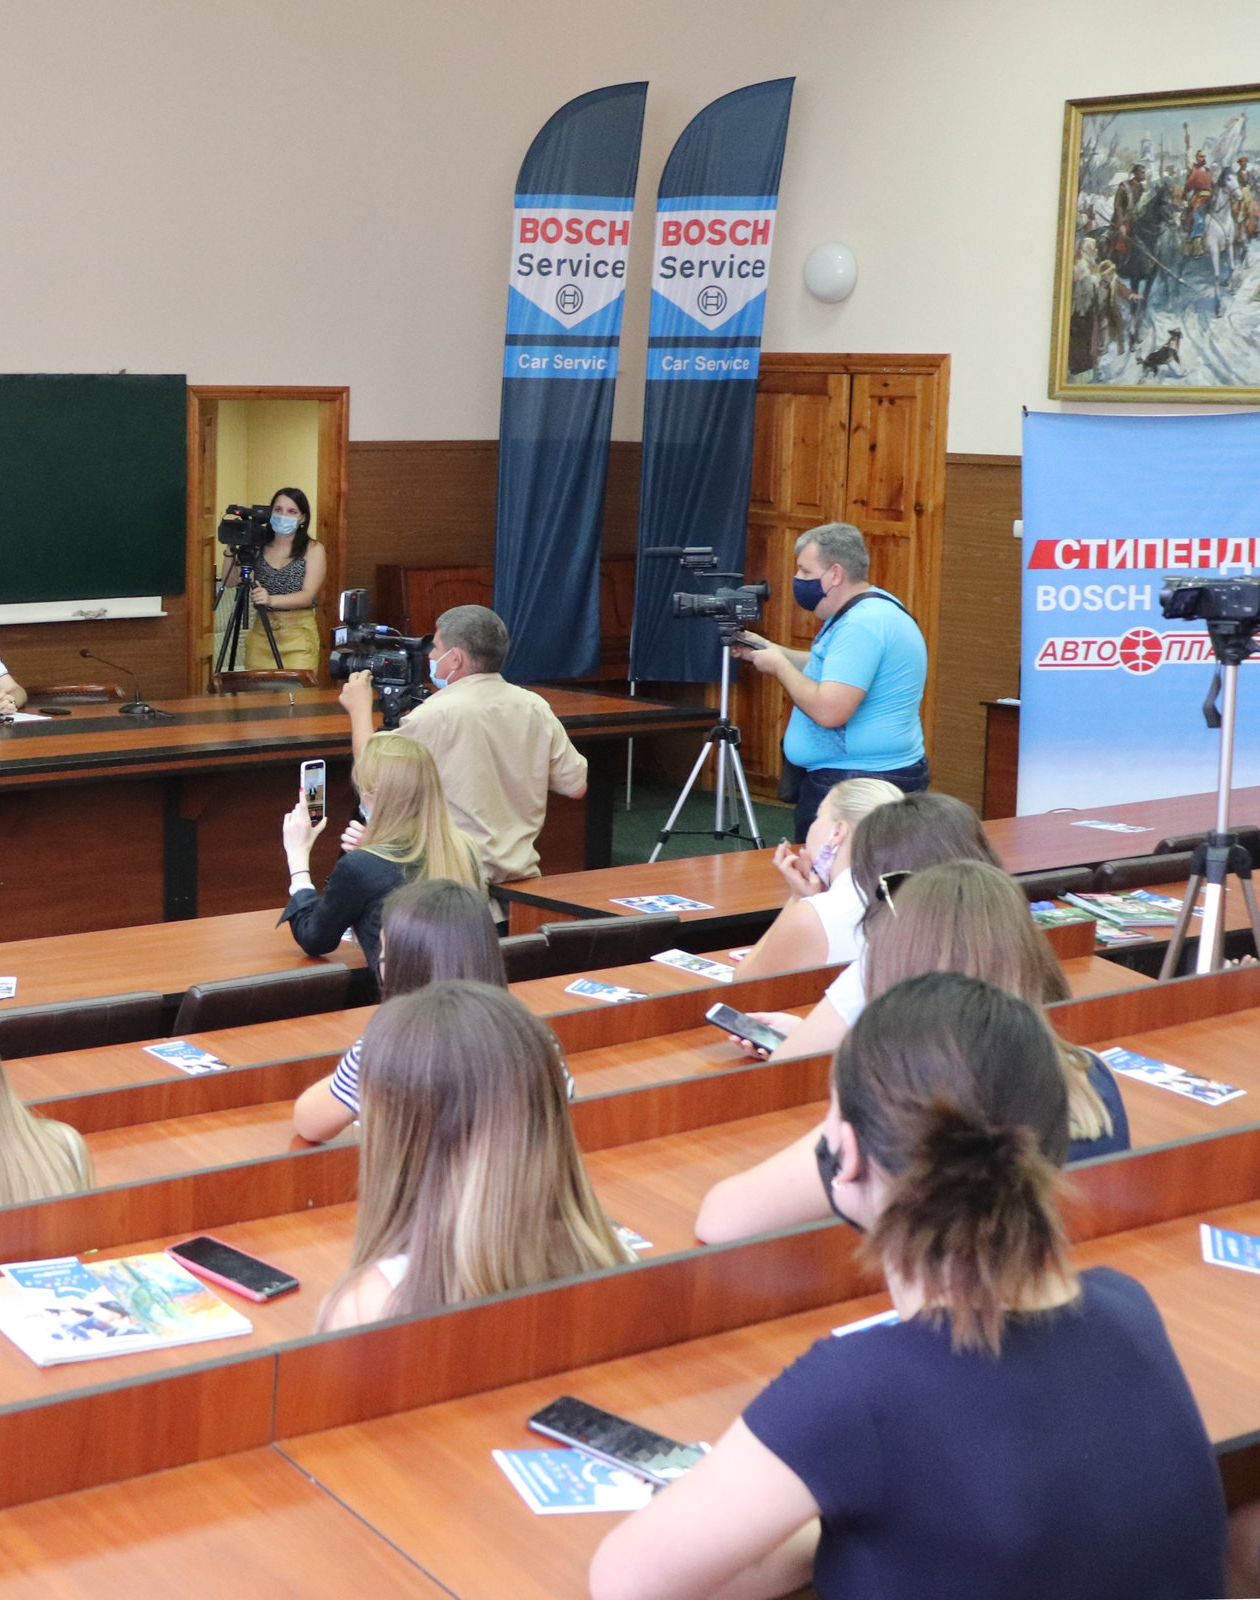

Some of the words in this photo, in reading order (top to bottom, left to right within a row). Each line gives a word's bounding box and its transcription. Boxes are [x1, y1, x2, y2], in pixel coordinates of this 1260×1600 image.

[519, 217, 630, 246] BOSCH
[661, 218, 771, 247] BOSCH
[517, 253, 625, 279] Service
[659, 254, 765, 279] Service
[518, 353, 549, 369] Car
[553, 354, 608, 370] Servic
[662, 355, 690, 371] Car
[694, 355, 750, 371] Service
[1054, 537, 1260, 575] СТИПЕНД
[1036, 584, 1152, 612] BOSCH
[1039, 640, 1117, 661] АВТО
